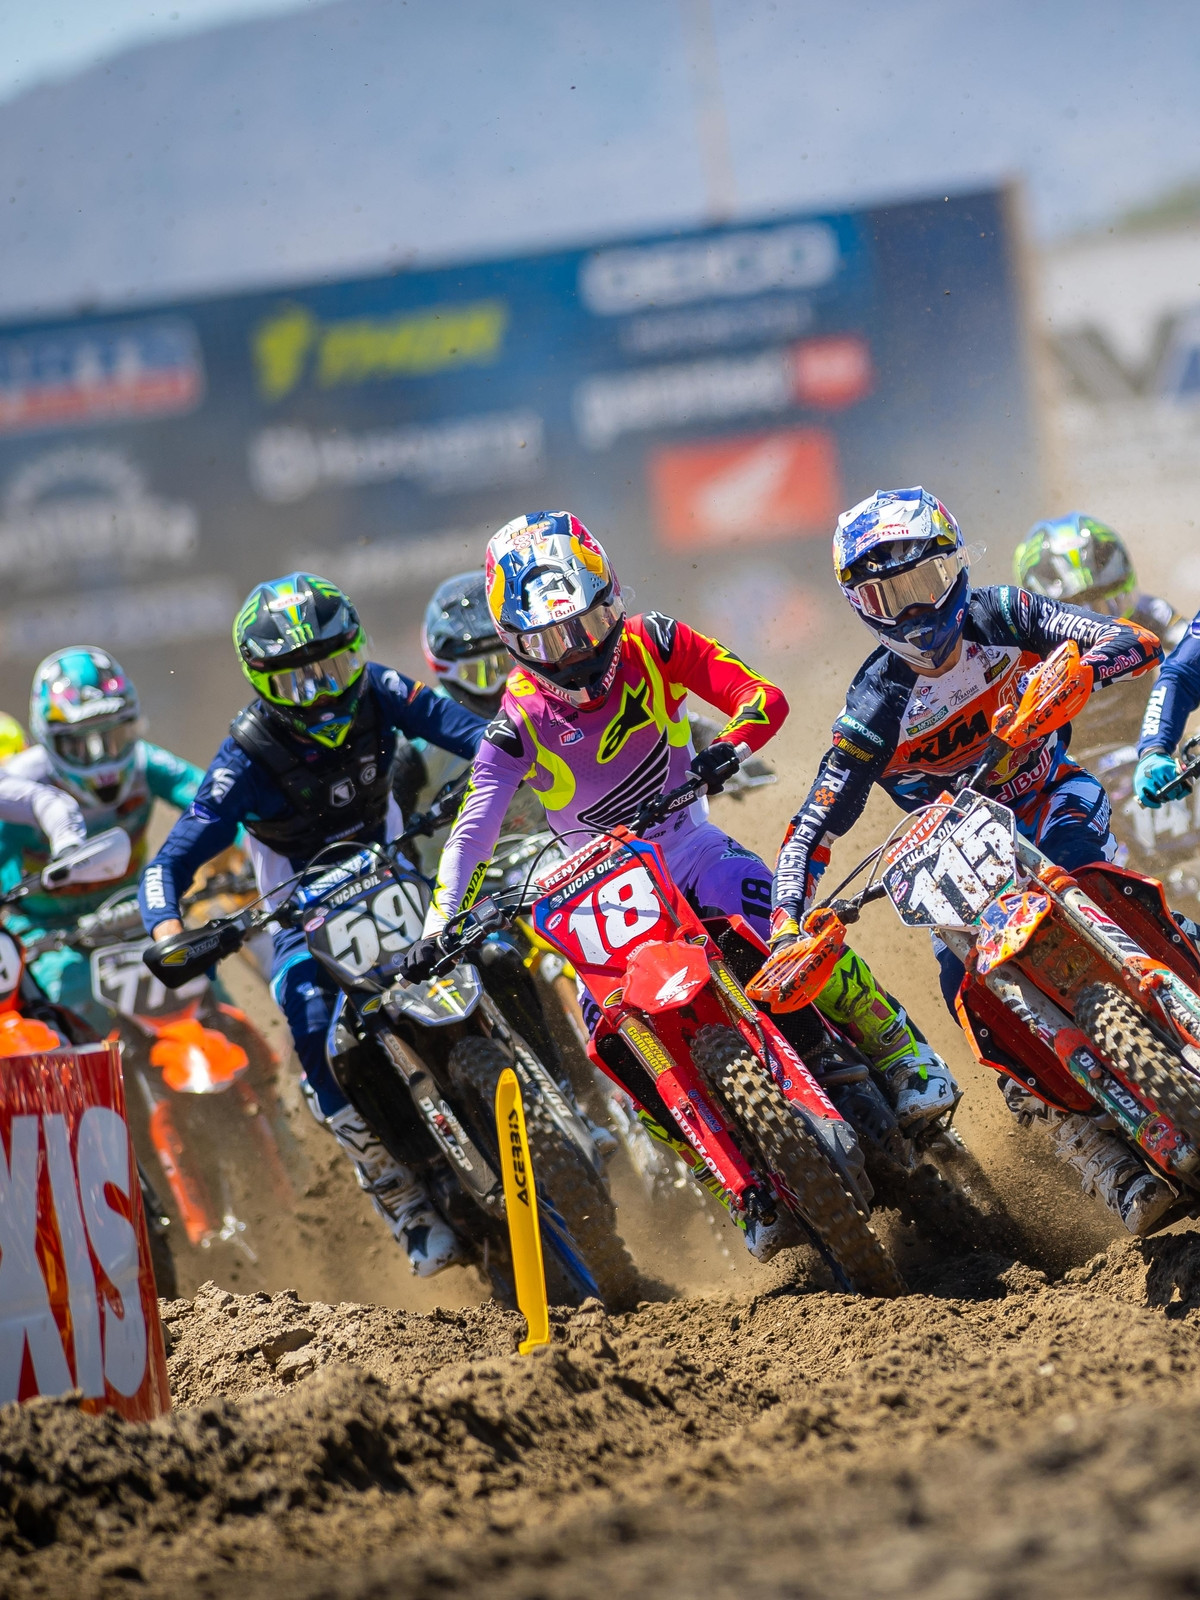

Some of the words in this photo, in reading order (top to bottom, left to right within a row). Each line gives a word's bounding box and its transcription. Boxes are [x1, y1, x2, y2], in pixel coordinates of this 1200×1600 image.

[554, 605, 577, 619] Bull
[1099, 656, 1121, 679] Red
[1120, 647, 1142, 669] Bull
[849, 718, 885, 746] MOTOREX
[917, 706, 949, 732] MOTOREX
[1142, 686, 1168, 737] THOR
[563, 730, 583, 744] 100%
[908, 710, 990, 764] KTM
[1013, 746, 1052, 797] Bull
[668, 791, 695, 810] ARC
[939, 819, 957, 840] OIL
[361, 873, 382, 891] OIL
[563, 868, 595, 899] LUCAS
[596, 859, 615, 875] OIL
[908, 805, 1016, 926] 115
[144, 865, 167, 910] THOR
[740, 876, 773, 922] 18
[326, 881, 425, 977] 59
[568, 866, 661, 965] 18
[660, 979, 701, 1007] HONDA
[773, 1035, 836, 1112] DUNLOP
[670, 1104, 727, 1185] DUNLOP
